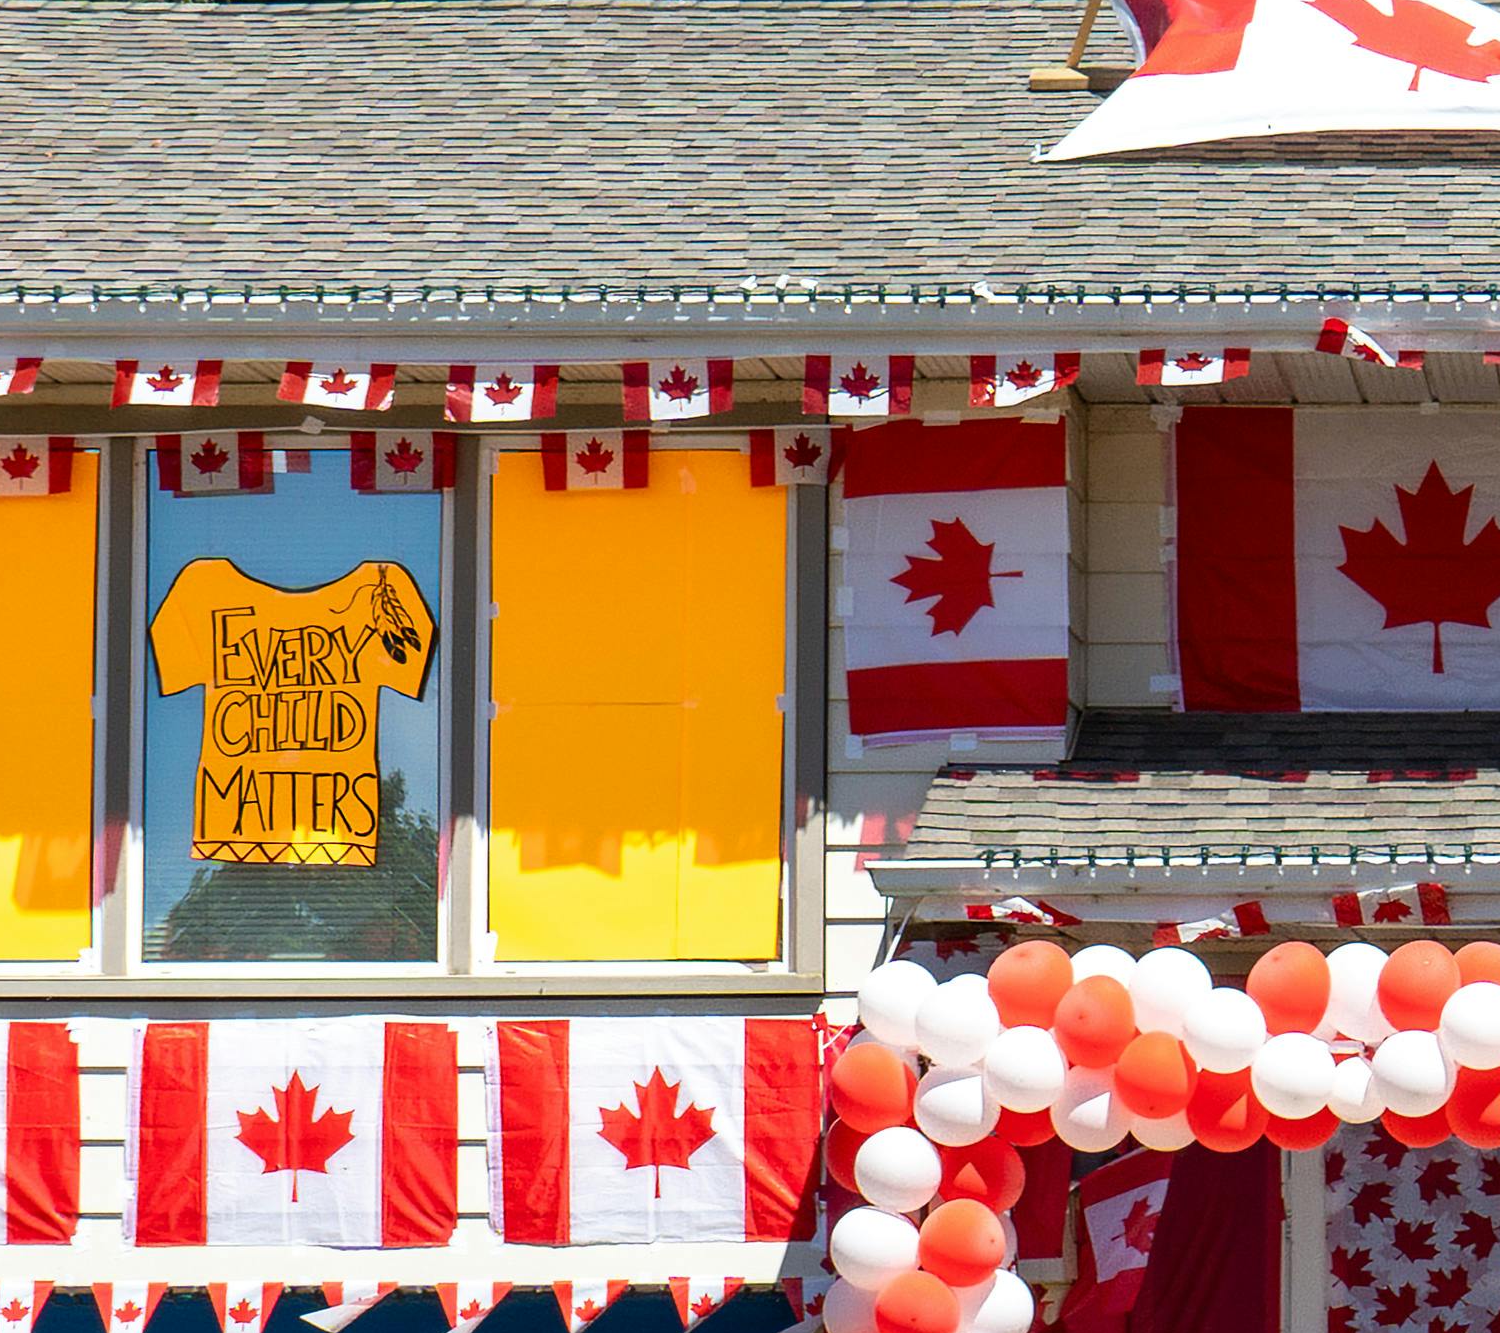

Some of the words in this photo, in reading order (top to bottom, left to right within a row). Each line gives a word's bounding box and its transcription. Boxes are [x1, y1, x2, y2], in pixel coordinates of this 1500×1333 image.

[211, 606, 376, 691] EVERY
[211, 690, 366, 757] CHILD
[200, 765, 377, 840] MATTERS
